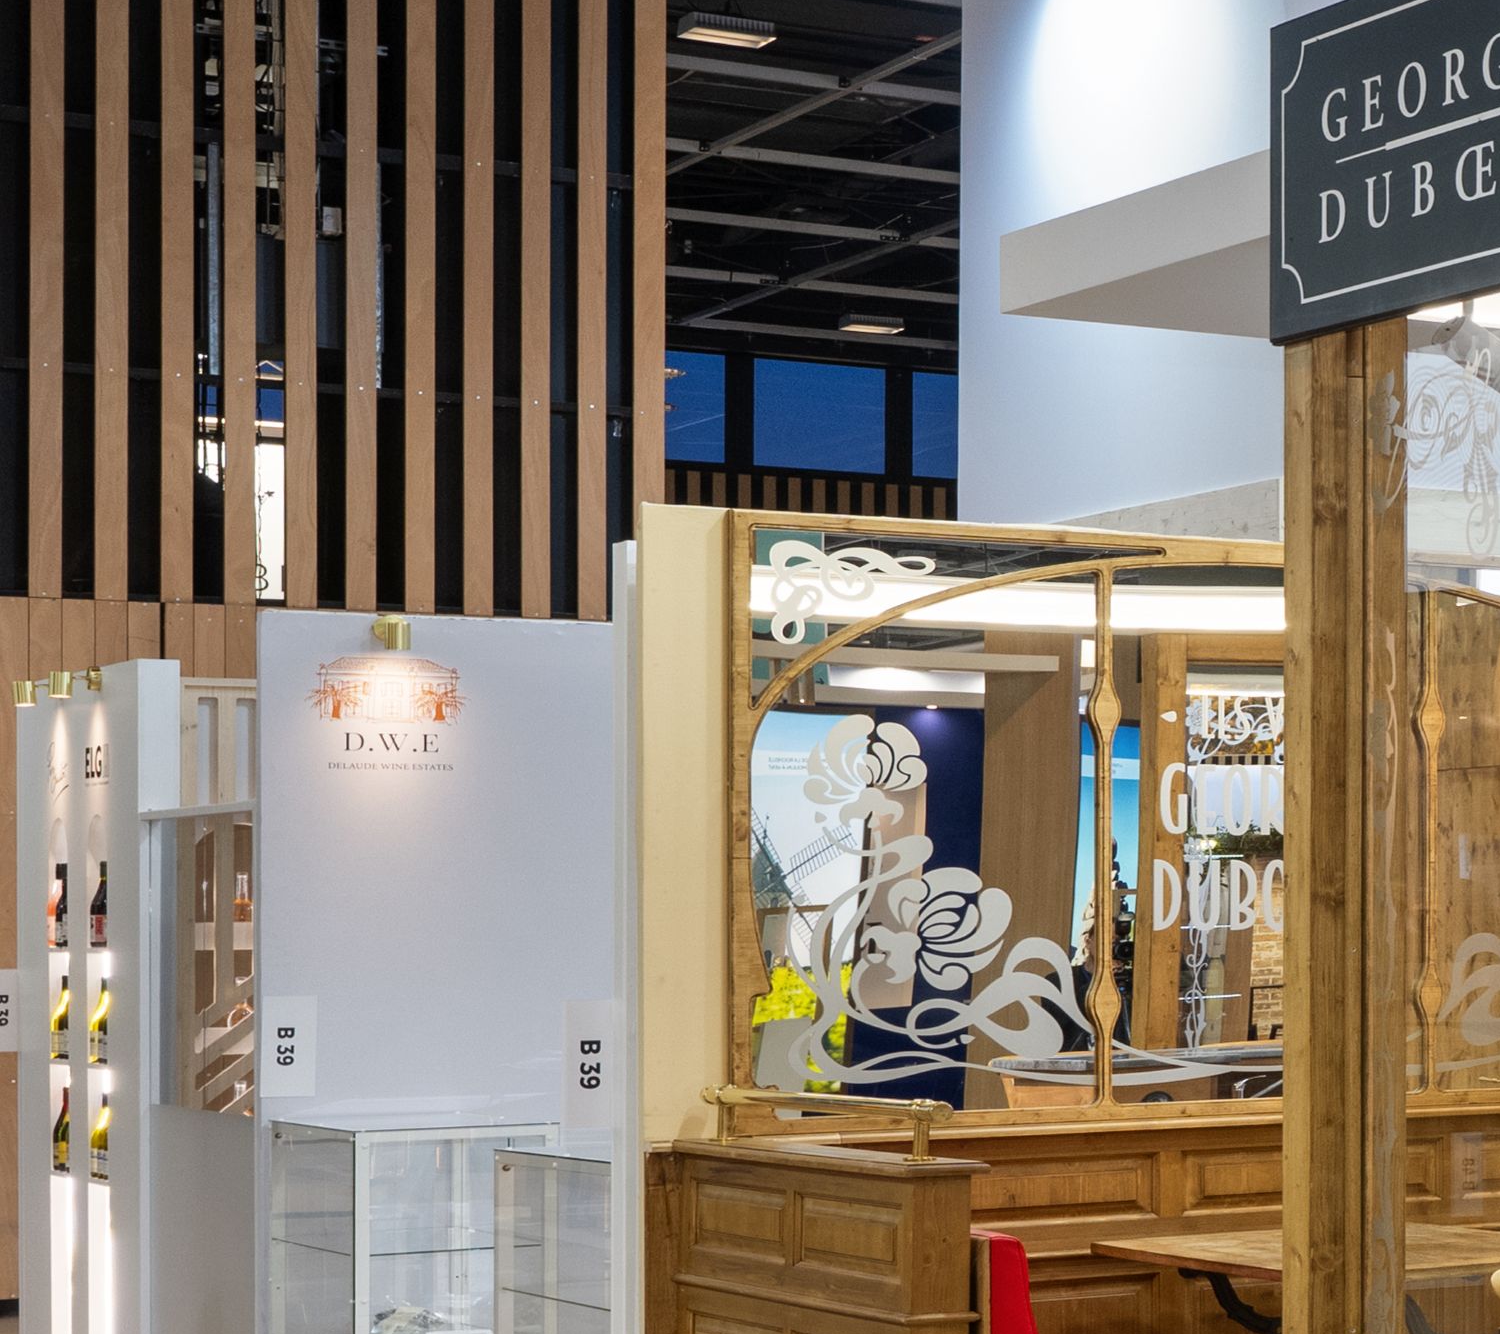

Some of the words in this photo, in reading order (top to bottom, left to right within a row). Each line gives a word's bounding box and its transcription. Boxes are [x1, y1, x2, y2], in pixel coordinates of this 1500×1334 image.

[328, 761, 378, 770] DELAUDE
[412, 763, 454, 771] ESTATES
[1160, 762, 1284, 836] GEOR
[277, 1027, 295, 1039] B
[276, 1044, 295, 1066] 39
[580, 1040, 601, 1055] B
[580, 1062, 601, 1089] 39
